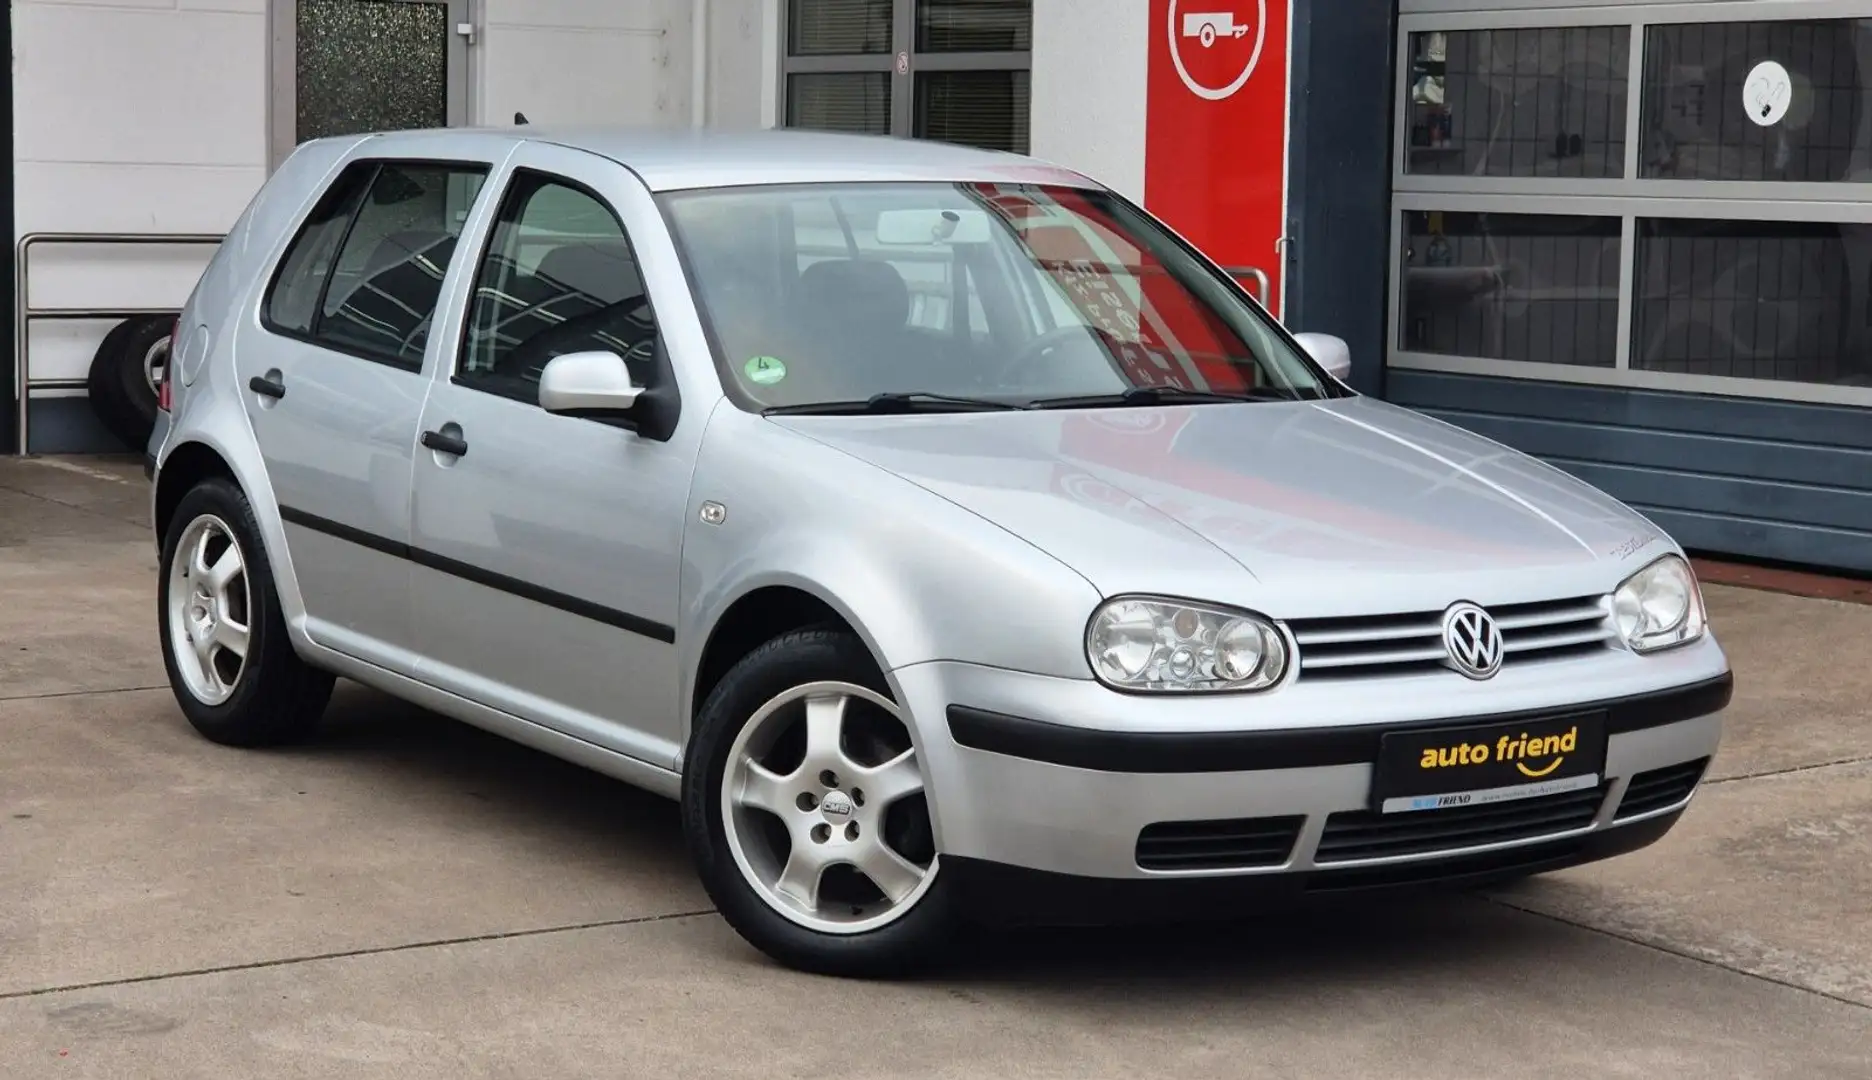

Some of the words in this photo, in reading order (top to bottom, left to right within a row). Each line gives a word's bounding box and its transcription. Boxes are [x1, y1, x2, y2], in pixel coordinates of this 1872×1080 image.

[1449, 607, 1500, 674] VW
[1420, 743, 1490, 769] auto
[1496, 727, 1578, 761] friend
[823, 801, 851, 815] CMS
[1437, 794, 1471, 807] FRIEND
